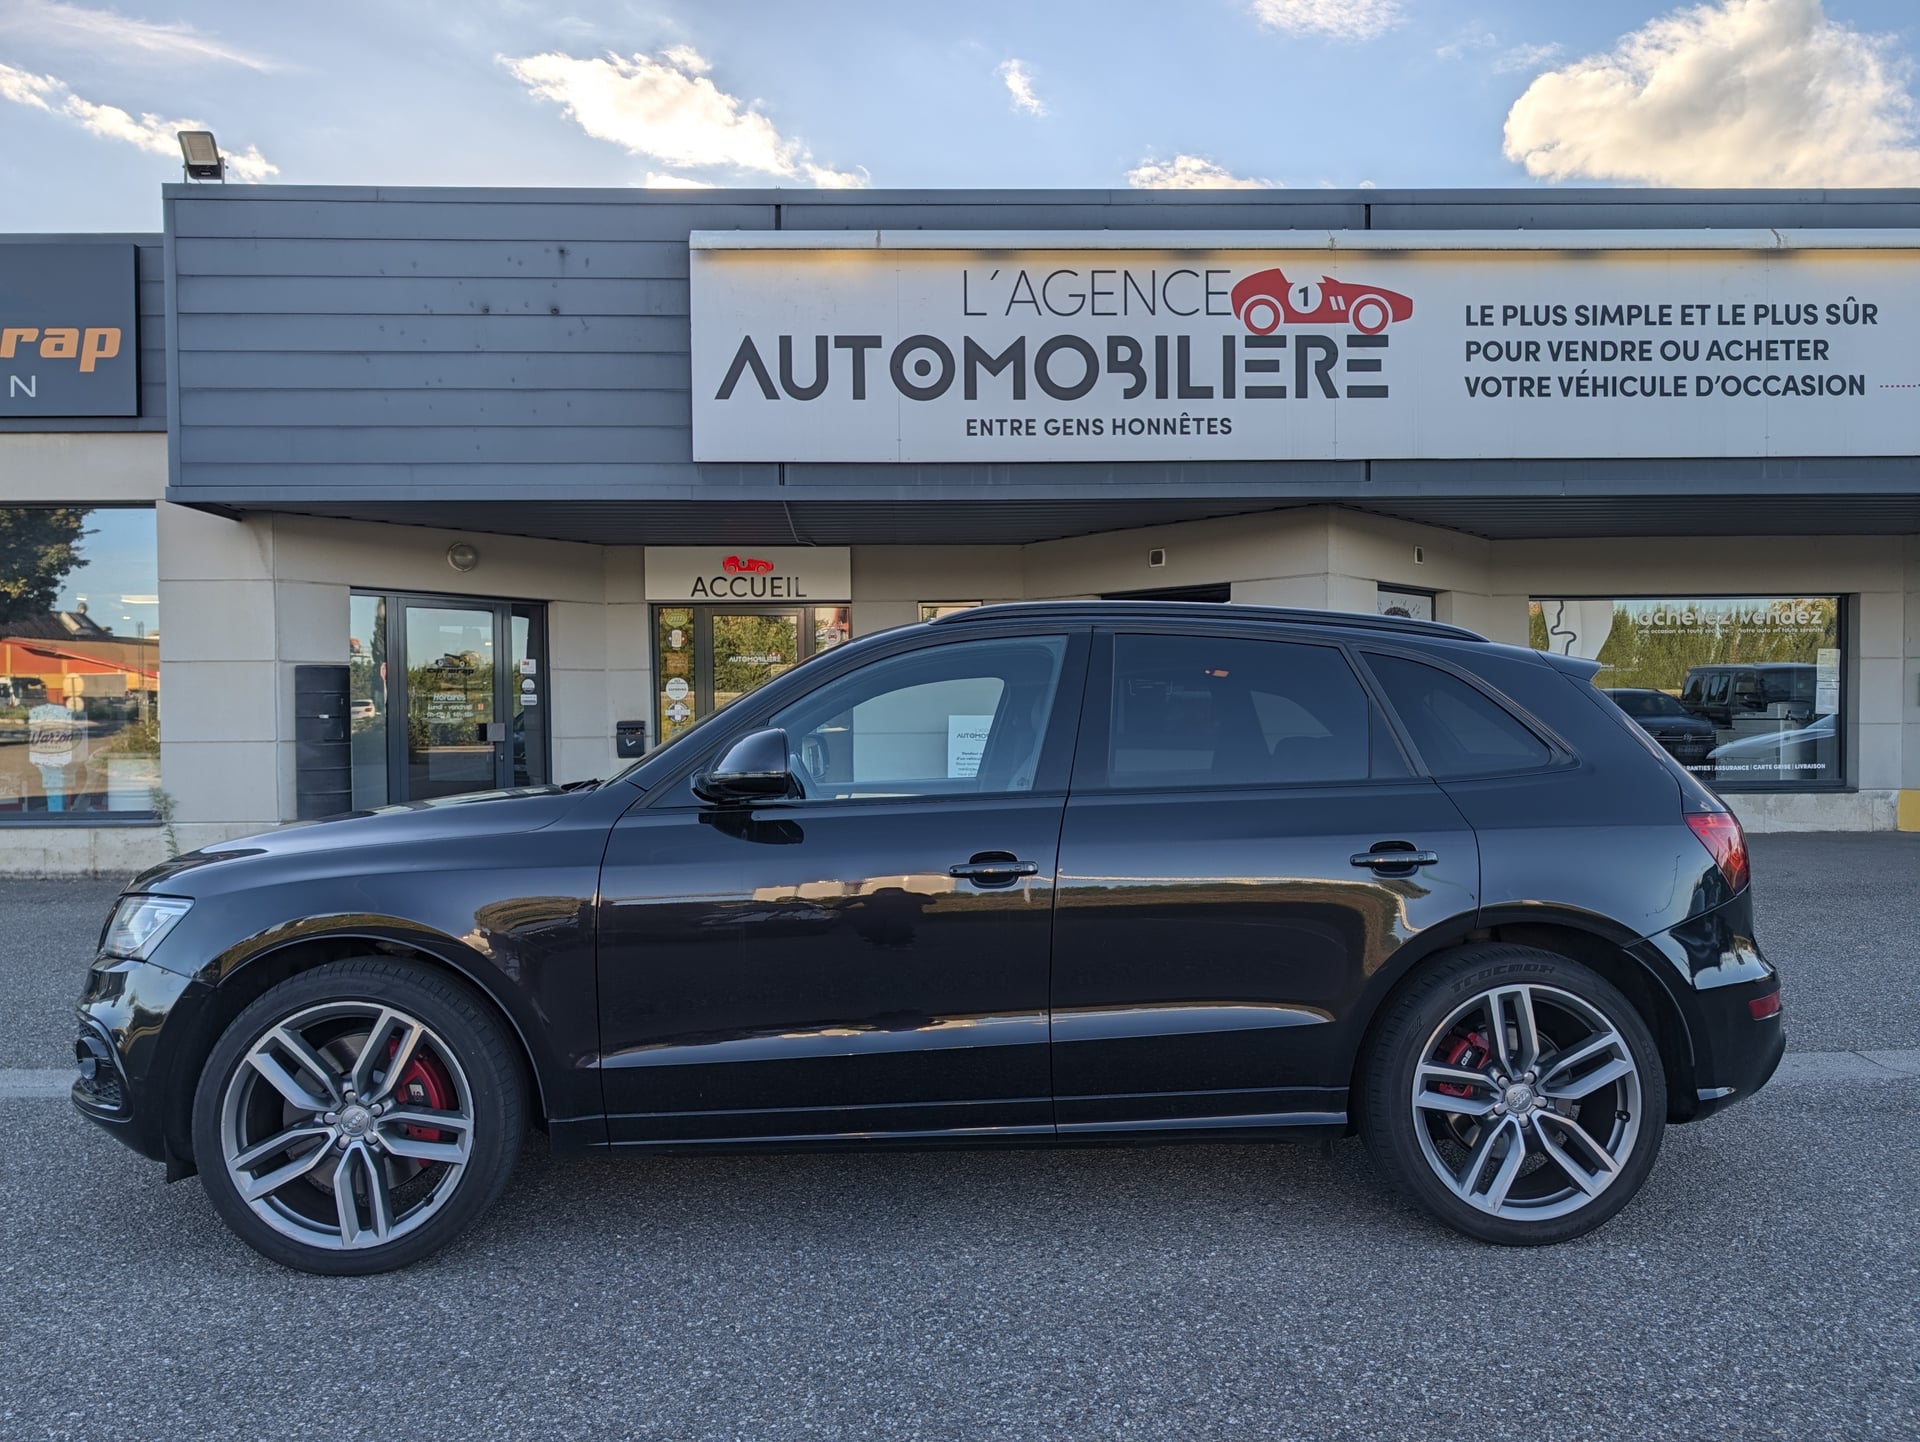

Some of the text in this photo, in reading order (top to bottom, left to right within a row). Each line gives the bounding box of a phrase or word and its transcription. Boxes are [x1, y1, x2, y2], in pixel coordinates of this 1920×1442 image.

[1465, 297, 1878, 327] LE PLUS SIMPLE ET LE PLUS SÛR
[1465, 339, 1829, 362] POUR VENDRE OU ACHETER
[1464, 368, 1865, 398] VOTRE VÉHICULE D'OCCASION
[966, 412, 1233, 437] ENTRE GENS HONNÊTES
[690, 576, 808, 598] ACCUEIL
[1637, 604, 1731, 626] achetez
[1741, 601, 1823, 625] vendez
